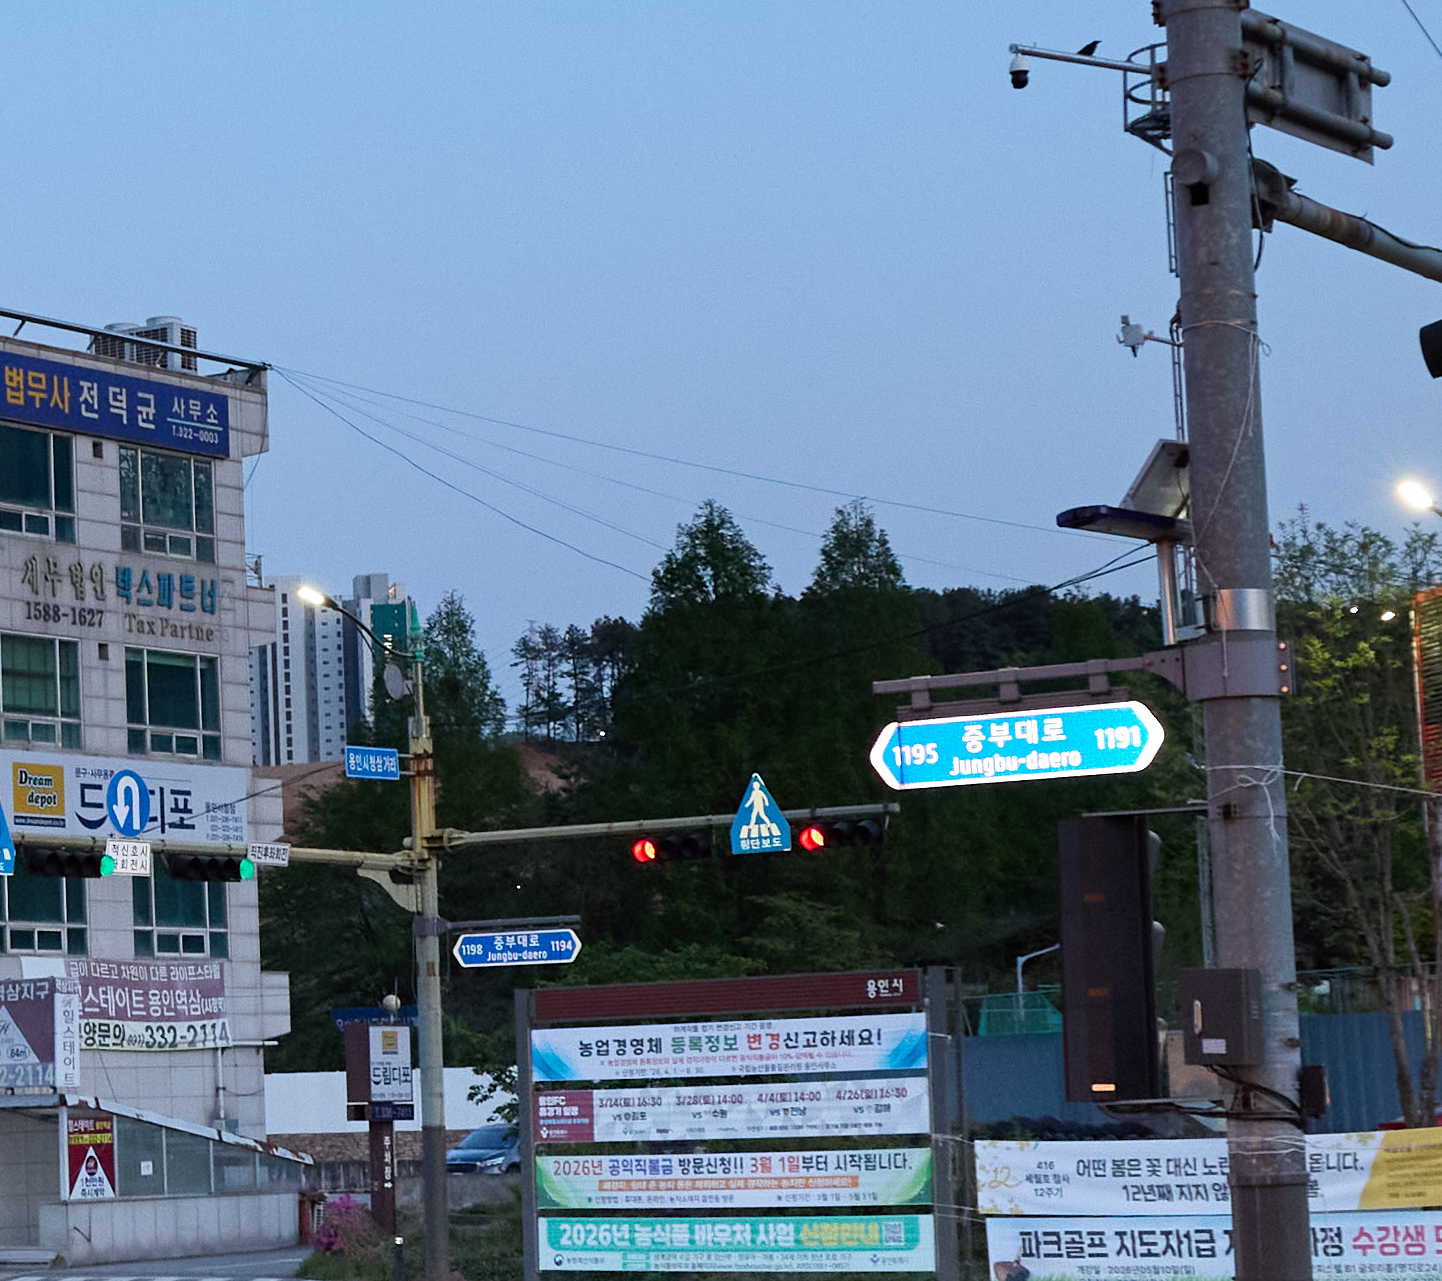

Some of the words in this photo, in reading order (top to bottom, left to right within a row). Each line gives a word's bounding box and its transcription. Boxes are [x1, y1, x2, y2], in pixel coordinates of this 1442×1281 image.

[4, 366, 70, 413] 법무사
[79, 380, 156, 429] 전덕균
[172, 397, 219, 425] 사무소
[172, 425, 219, 444] T.322-0003
[26, 601, 104, 628] 1588-1627
[125, 612, 155, 636] Tax
[161, 617, 214, 642] Partne
[892, 743, 939, 766] 1195
[961, 718, 1066, 753] 중부대로
[1094, 726, 1142, 750] 1191
[949, 750, 1082, 777] Jungbu-daero
[18, 770, 54, 786] Dream
[27, 789, 57, 806] depot
[740, 837, 782, 850] 횡단보도
[462, 944, 483, 955] 1198
[493, 935, 540, 951] 중부대로
[550, 940, 573, 952] 1194
[487, 950, 547, 963] Jungbu-daero
[91, 963, 118, 979] 다르고
[121, 965, 147, 981] 차원이
[867, 978, 903, 998] 용인시
[579, 1037, 662, 1058] 농업경영체
[671, 1034, 739, 1054] 등록정보
[372, 1066, 412, 1085] 드림디포
[637, 1096, 662, 1107] 16:30
[717, 1093, 743, 1104] 14:00
[794, 1091, 821, 1102] 14:00
[880, 1088, 907, 1099] 16:30
[554, 1160, 603, 1176] 2026년
[609, 1157, 673, 1176] 공익직불금
[679, 1157, 744, 1175] 방문신청!!
[750, 1156, 772, 1174] 3월
[778, 1154, 828, 1173] 1일부터
[834, 1153, 913, 1171] 시작됩니다.
[1036, 1161, 1055, 1170] 416
[1076, 1159, 1106, 1178] 어떤
[1111, 1159, 1141, 1177] 봄은
[1147, 1158, 1162, 1177] 꽃
[1166, 1158, 1197, 1177] 대신
[1025, 1174, 1051, 1184] 세월호
[1034, 1188, 1063, 1199] 12주기
[559, 1223, 629, 1246] 2026년
[634, 1223, 690, 1247] 농식품
[694, 1223, 751, 1247] 바우처
[757, 1223, 794, 1247] 사업
[1019, 1230, 1109, 1259] 파크골프
[1115, 1229, 1216, 1259] 지도자1급
[1353, 1224, 1426, 1257] 수강생
